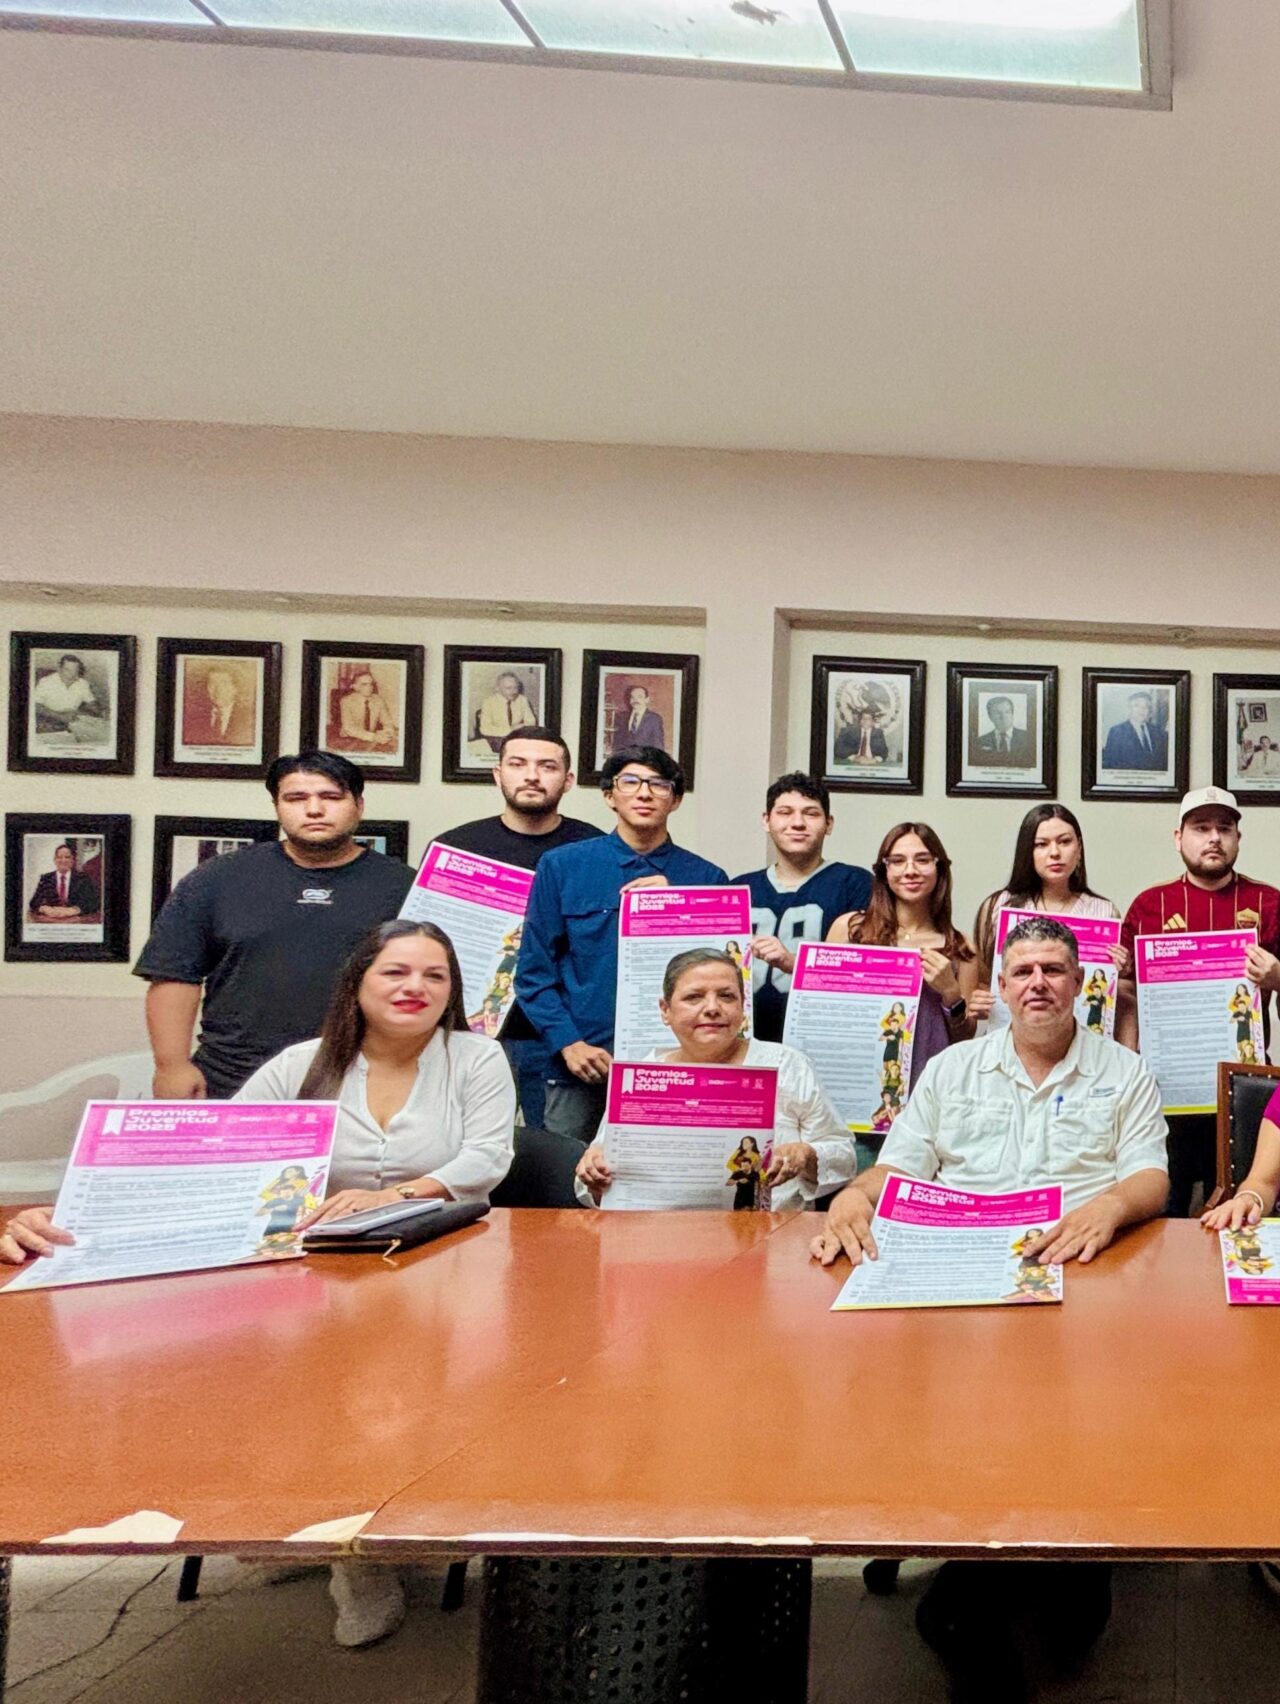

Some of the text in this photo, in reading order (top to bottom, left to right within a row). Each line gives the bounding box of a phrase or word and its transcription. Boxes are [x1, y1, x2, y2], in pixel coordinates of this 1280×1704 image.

[636, 1069, 688, 1078] Premios
[635, 1077, 695, 1086] Juventud
[635, 1084, 668, 1092] 2025
[128, 1109, 209, 1117] Premios
[125, 1115, 219, 1124] Juventud
[124, 1123, 177, 1132] 2025
